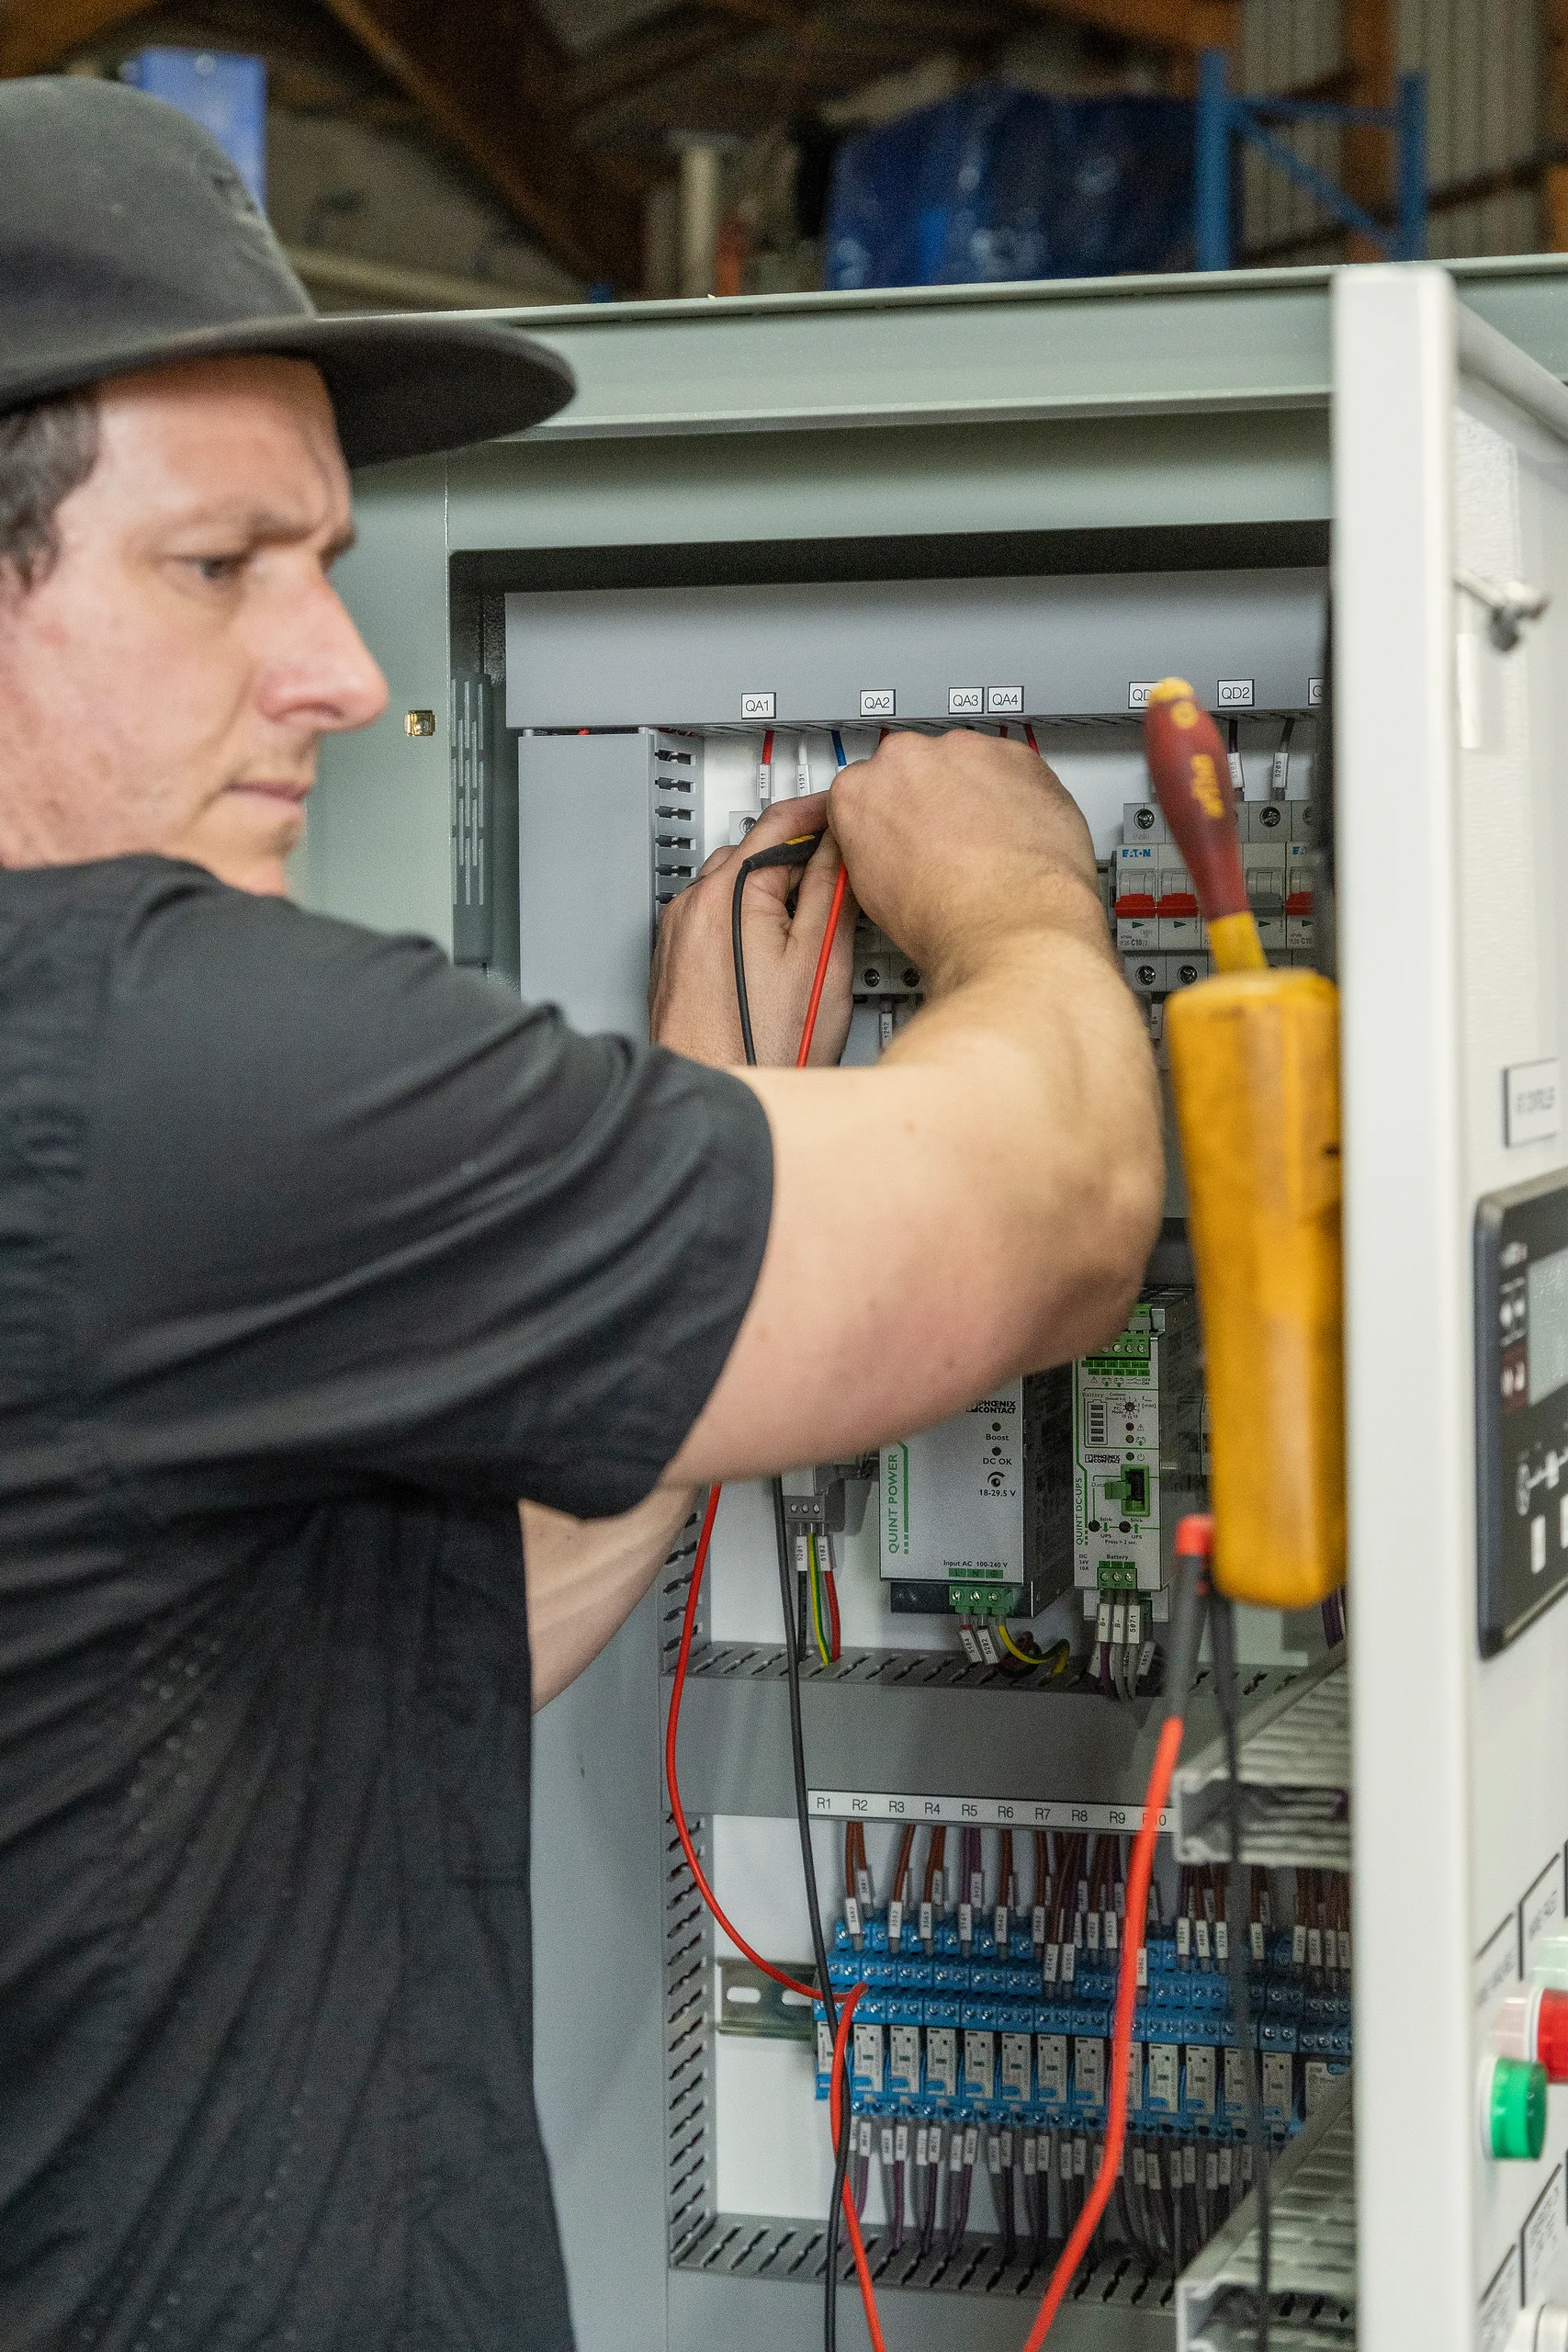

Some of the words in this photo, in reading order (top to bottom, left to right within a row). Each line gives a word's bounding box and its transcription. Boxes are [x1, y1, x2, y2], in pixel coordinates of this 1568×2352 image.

[1221, 686, 1250, 699] QD2
[745, 699, 770, 712] QA1
[863, 696, 890, 709] QA2
[953, 694, 979, 707] QA3
[992, 693, 1019, 706] QA4
[986, 1433, 1010, 1442] Boost
[983, 1457, 997, 1465] DC
[888, 1453, 898, 1505] POWER
[979, 1489, 1008, 1498] 18-29.5
[1010, 1489, 1016, 1498] V
[888, 1509, 899, 1555] QUINT
[943, 1559, 961, 1568] Input
[1100, 1616, 1106, 1627] B+
[817, 1797, 831, 1809] R1
[852, 1799, 868, 1812] R2
[888, 1801, 905, 1813] R3
[924, 1803, 941, 1815] R4
[961, 1804, 978, 1817] R5
[998, 1805, 1014, 1819] R6
[1035, 1807, 1051, 1821] R7
[1071, 1809, 1088, 1823] R8
[1109, 1811, 1126, 1825] R9
